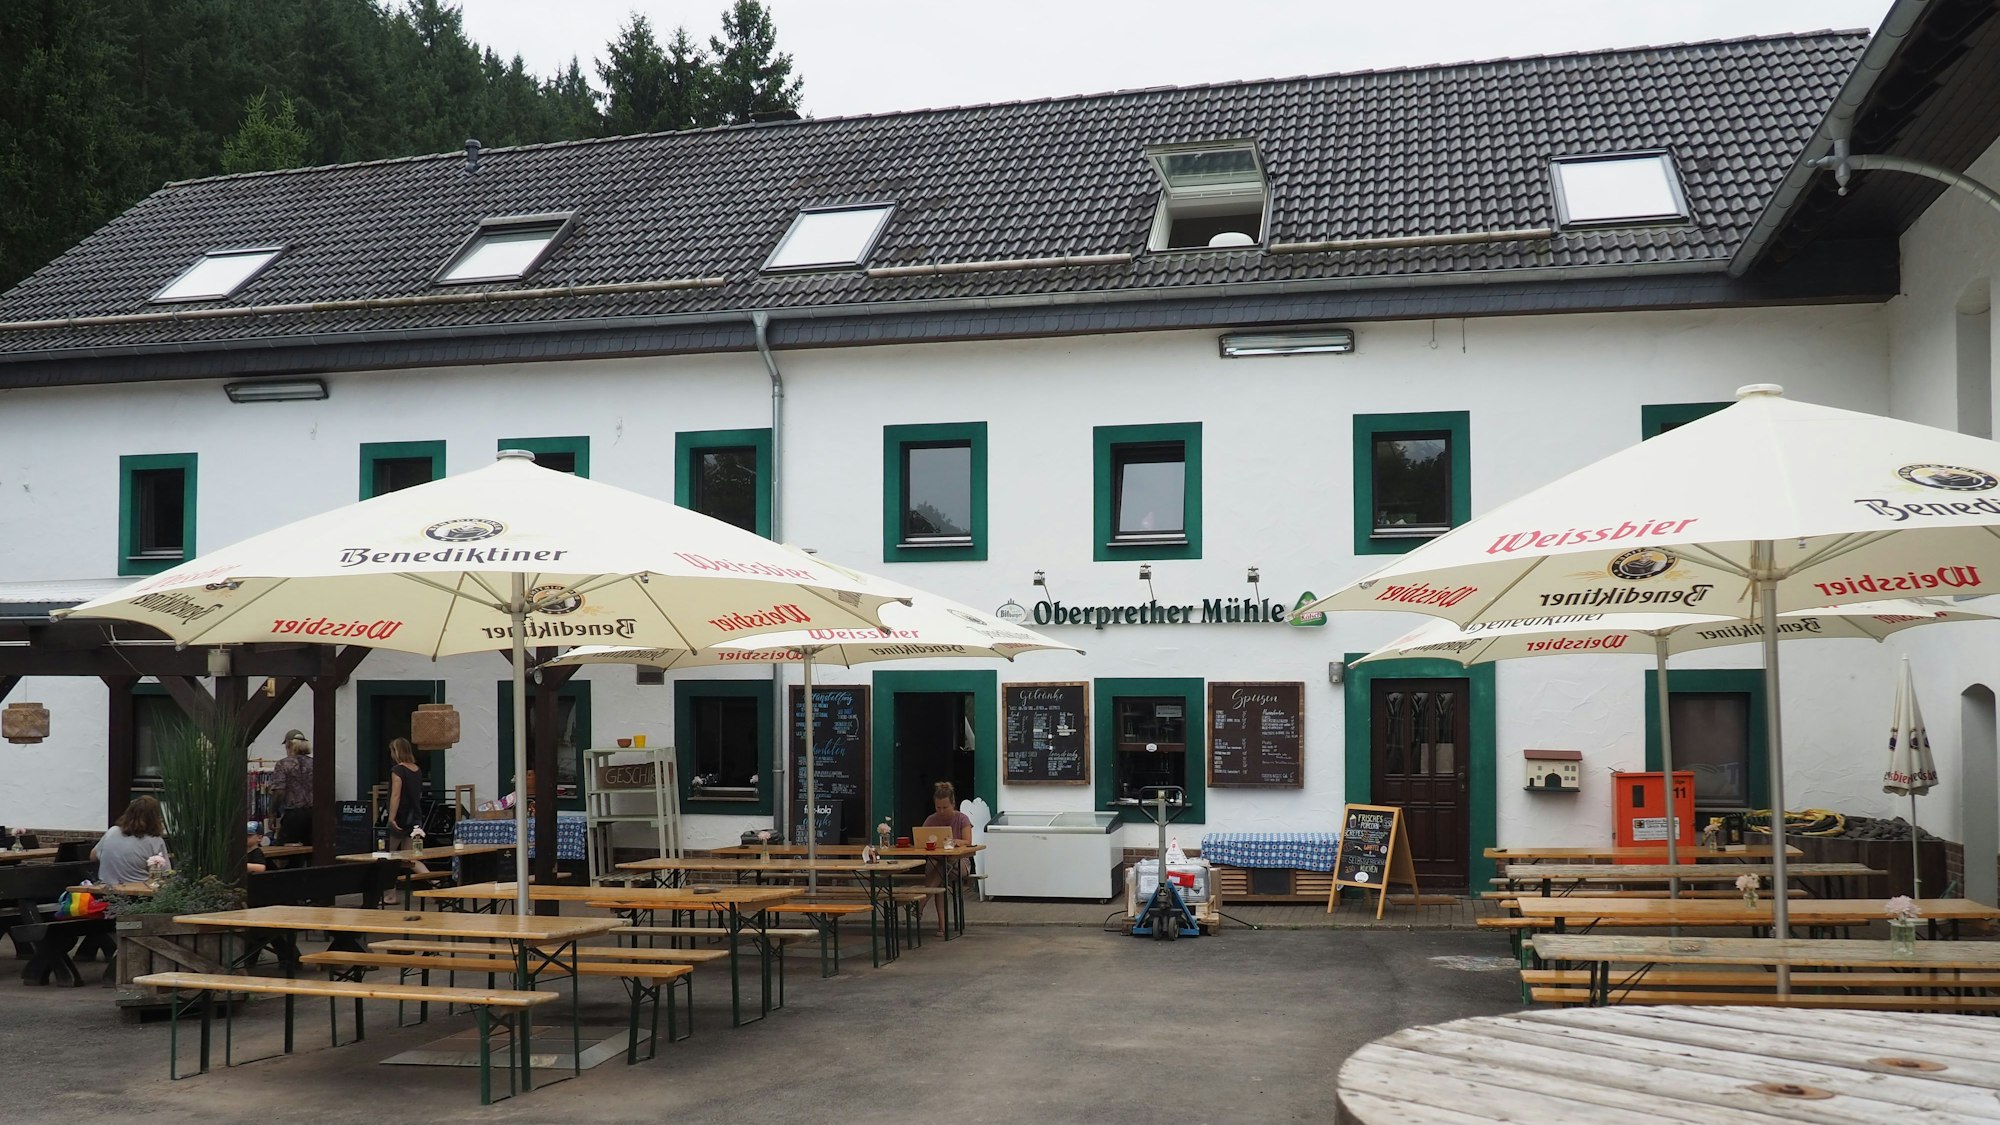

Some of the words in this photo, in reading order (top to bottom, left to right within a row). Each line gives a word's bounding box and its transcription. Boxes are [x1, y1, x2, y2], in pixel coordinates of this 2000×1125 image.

[1486, 518, 1698, 554] Weissbier
[339, 547, 568, 567] Benediktiner
[673, 552, 818, 580] Weissbier
[1033, 600, 1194, 629] Oberprether
[1201, 598, 1285, 623] Mühle
[1673, 787, 1686, 798] 11
[1358, 813, 1383, 823] FRISCHES
